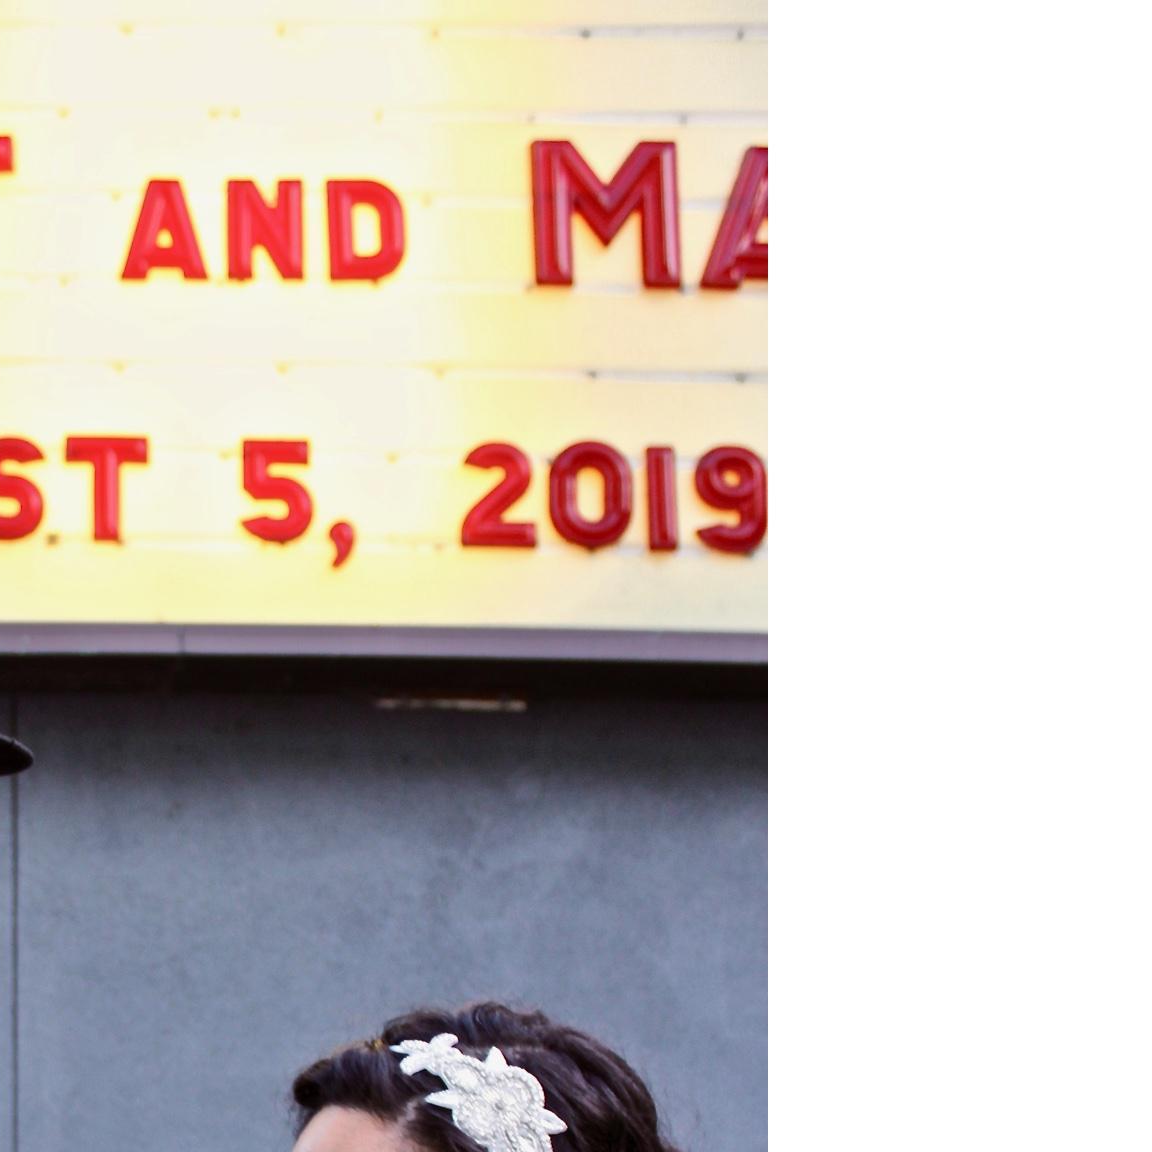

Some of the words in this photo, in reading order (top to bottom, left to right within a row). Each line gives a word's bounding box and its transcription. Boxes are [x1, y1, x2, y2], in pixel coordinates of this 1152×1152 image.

[121, 179, 405, 282] AND
[242, 440, 354, 568] 5,
[461, 441, 768, 555] 2019
